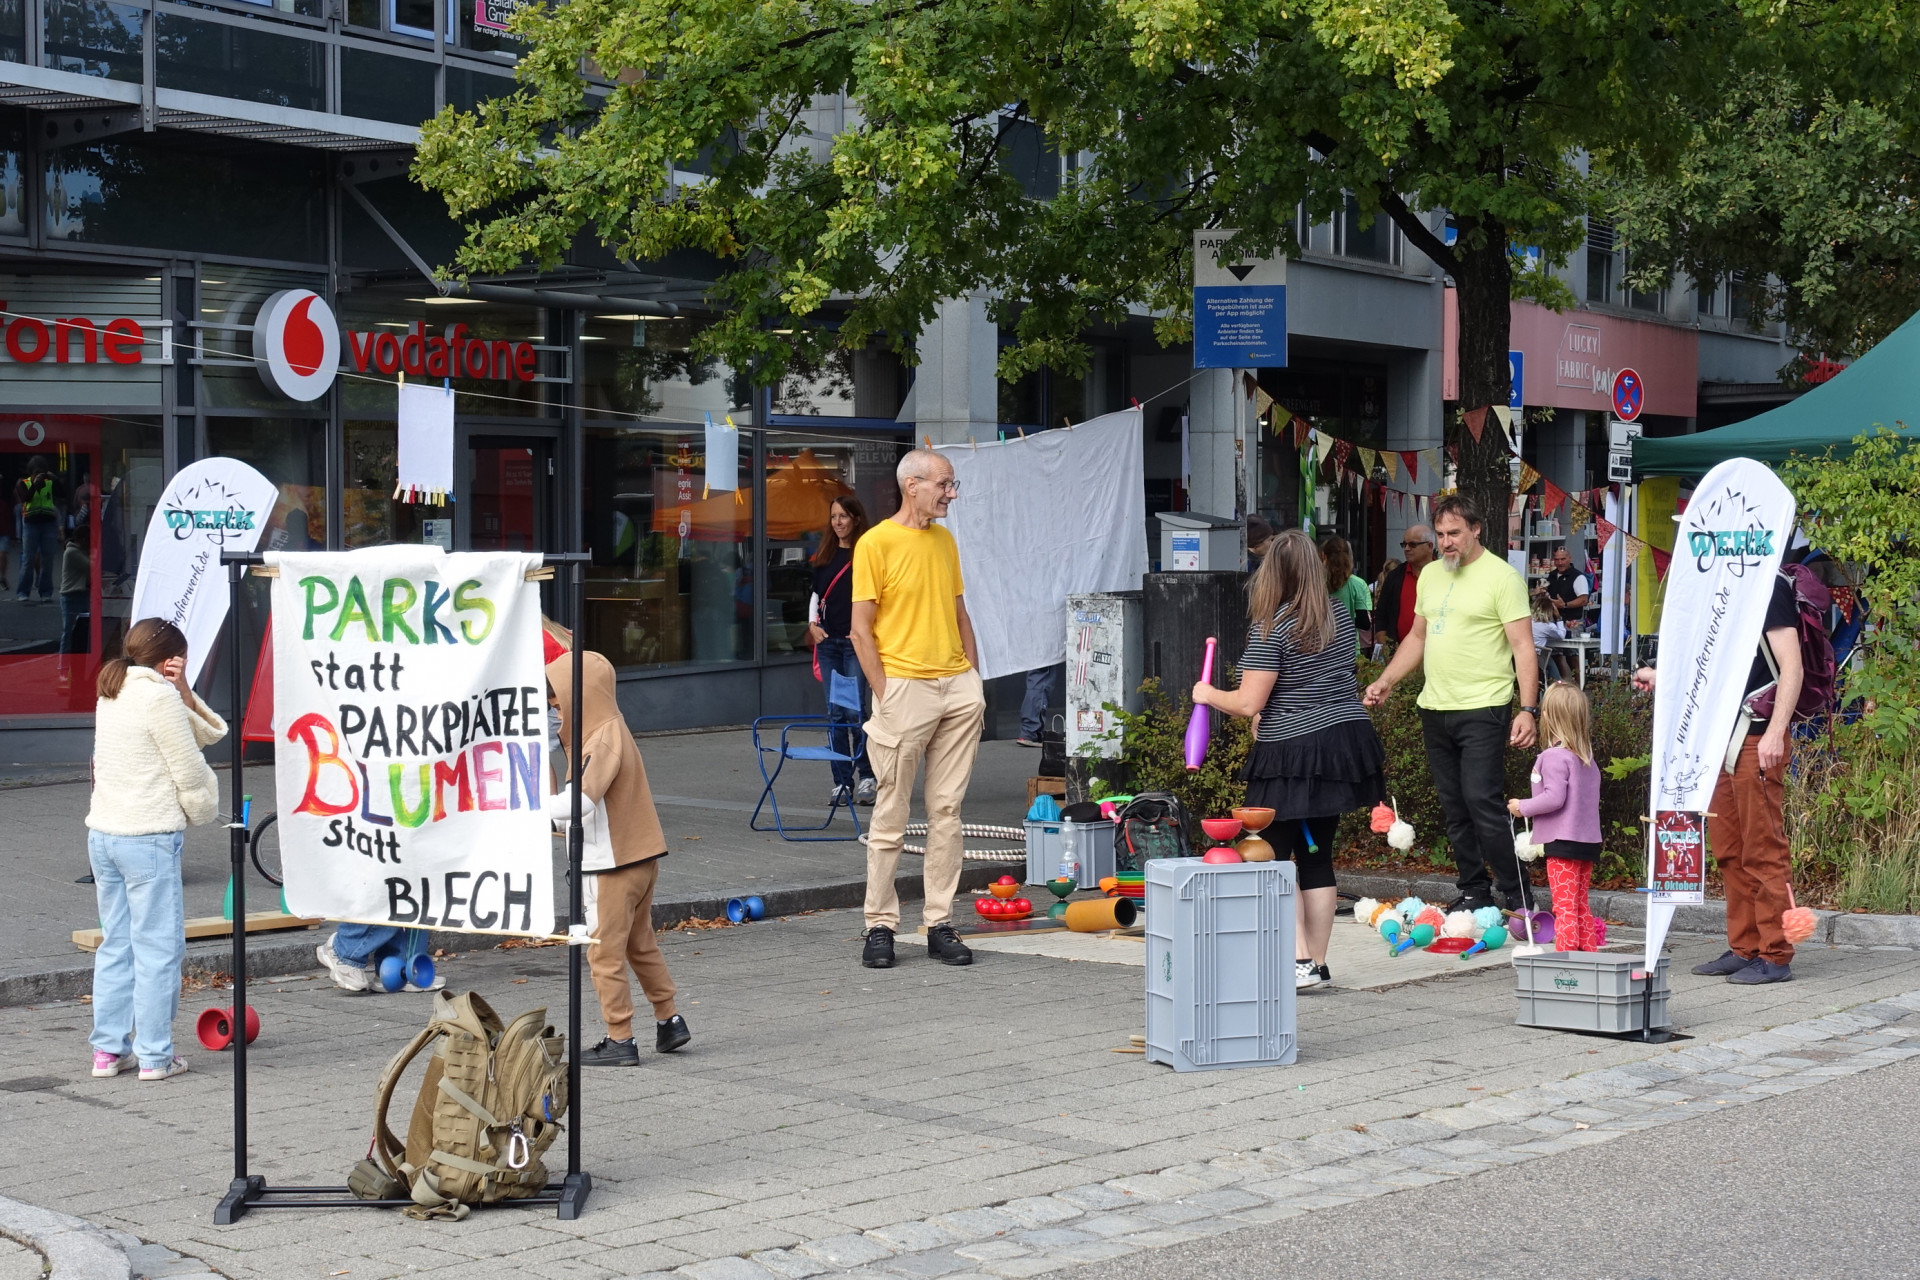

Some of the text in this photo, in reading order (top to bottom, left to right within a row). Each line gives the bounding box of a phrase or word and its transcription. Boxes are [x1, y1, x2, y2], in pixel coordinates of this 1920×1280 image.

[483, 27, 498, 37] richtige
[1239, 297, 1263, 305] Zahlung
[347, 320, 536, 382] vodafone
[1569, 333, 1598, 353] LUCKY
[1559, 359, 1590, 380] FABRIC
[168, 505, 253, 546] Jonglier
[1691, 523, 1774, 578] Jonglier
[171, 550, 210, 628] nglierwerk.de
[297, 574, 496, 647] PARKS
[311, 650, 405, 693] statt
[1676, 585, 1731, 746] www.jonglierwerk.de
[339, 686, 542, 760] PARKPLÄTZE
[286, 711, 543, 830] BLUMEN
[321, 815, 402, 865] statt
[384, 870, 533, 932] BLECH
[1664, 880, 1699, 891] Oktober
